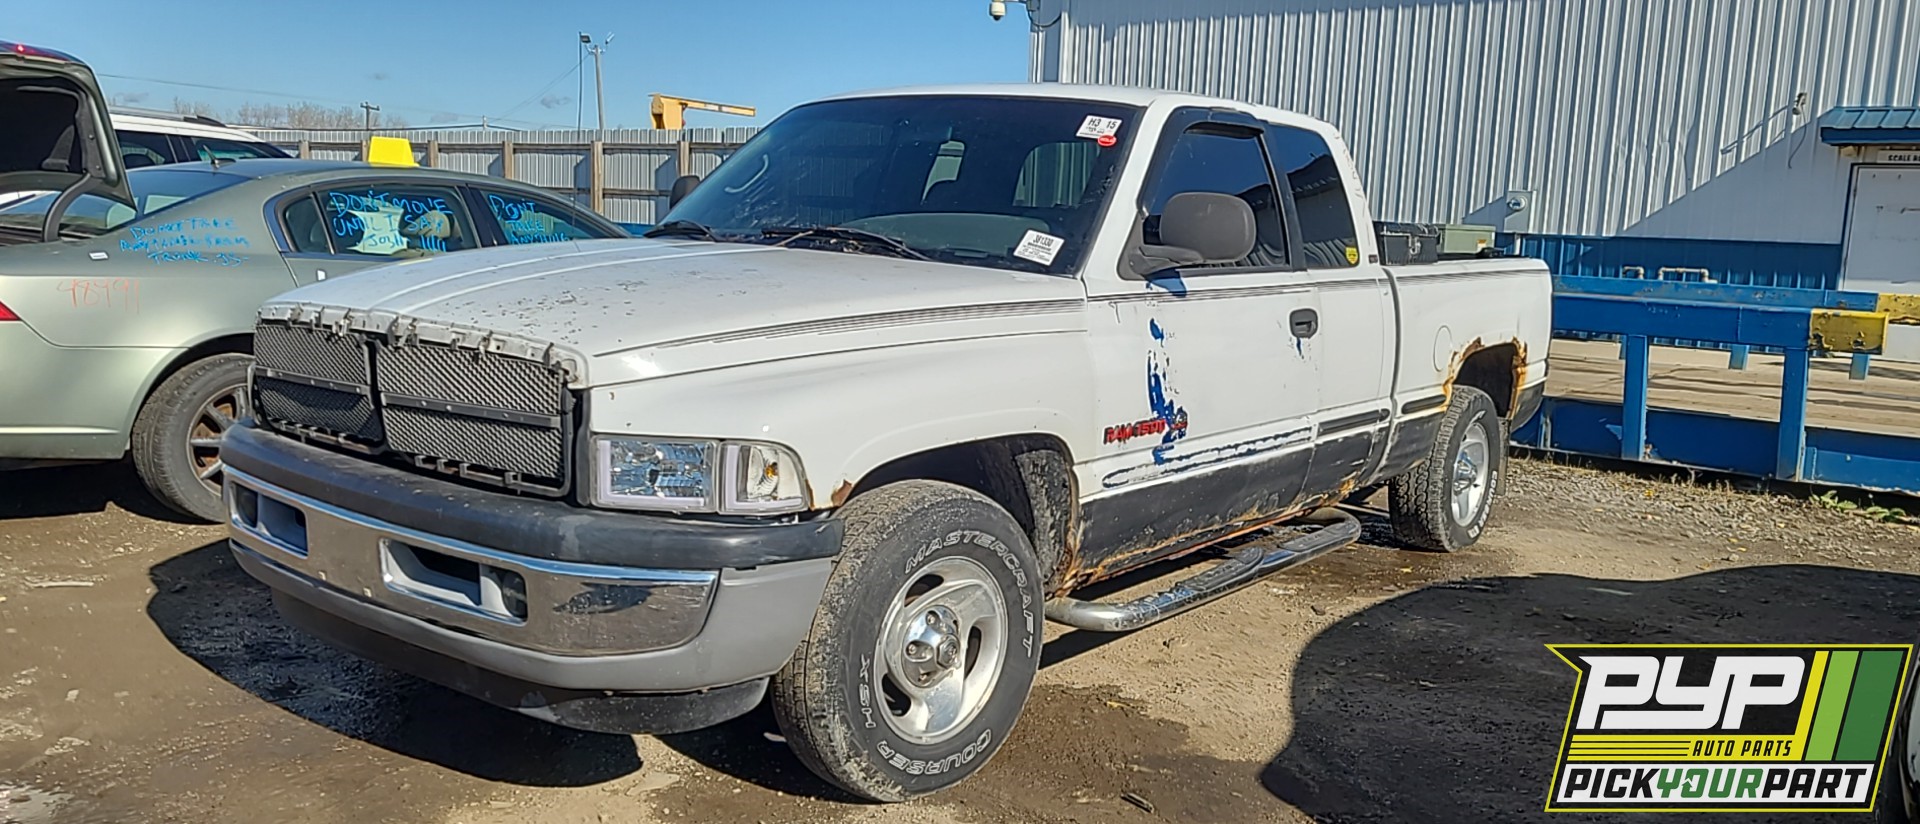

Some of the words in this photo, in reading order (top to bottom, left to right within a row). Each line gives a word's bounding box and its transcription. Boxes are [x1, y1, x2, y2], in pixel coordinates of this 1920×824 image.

[393, 196, 453, 215] MOVE
[1104, 423, 1133, 445] RAM
[904, 529, 1034, 658] MASTERCRAFT
[876, 729, 992, 776] COURSER
